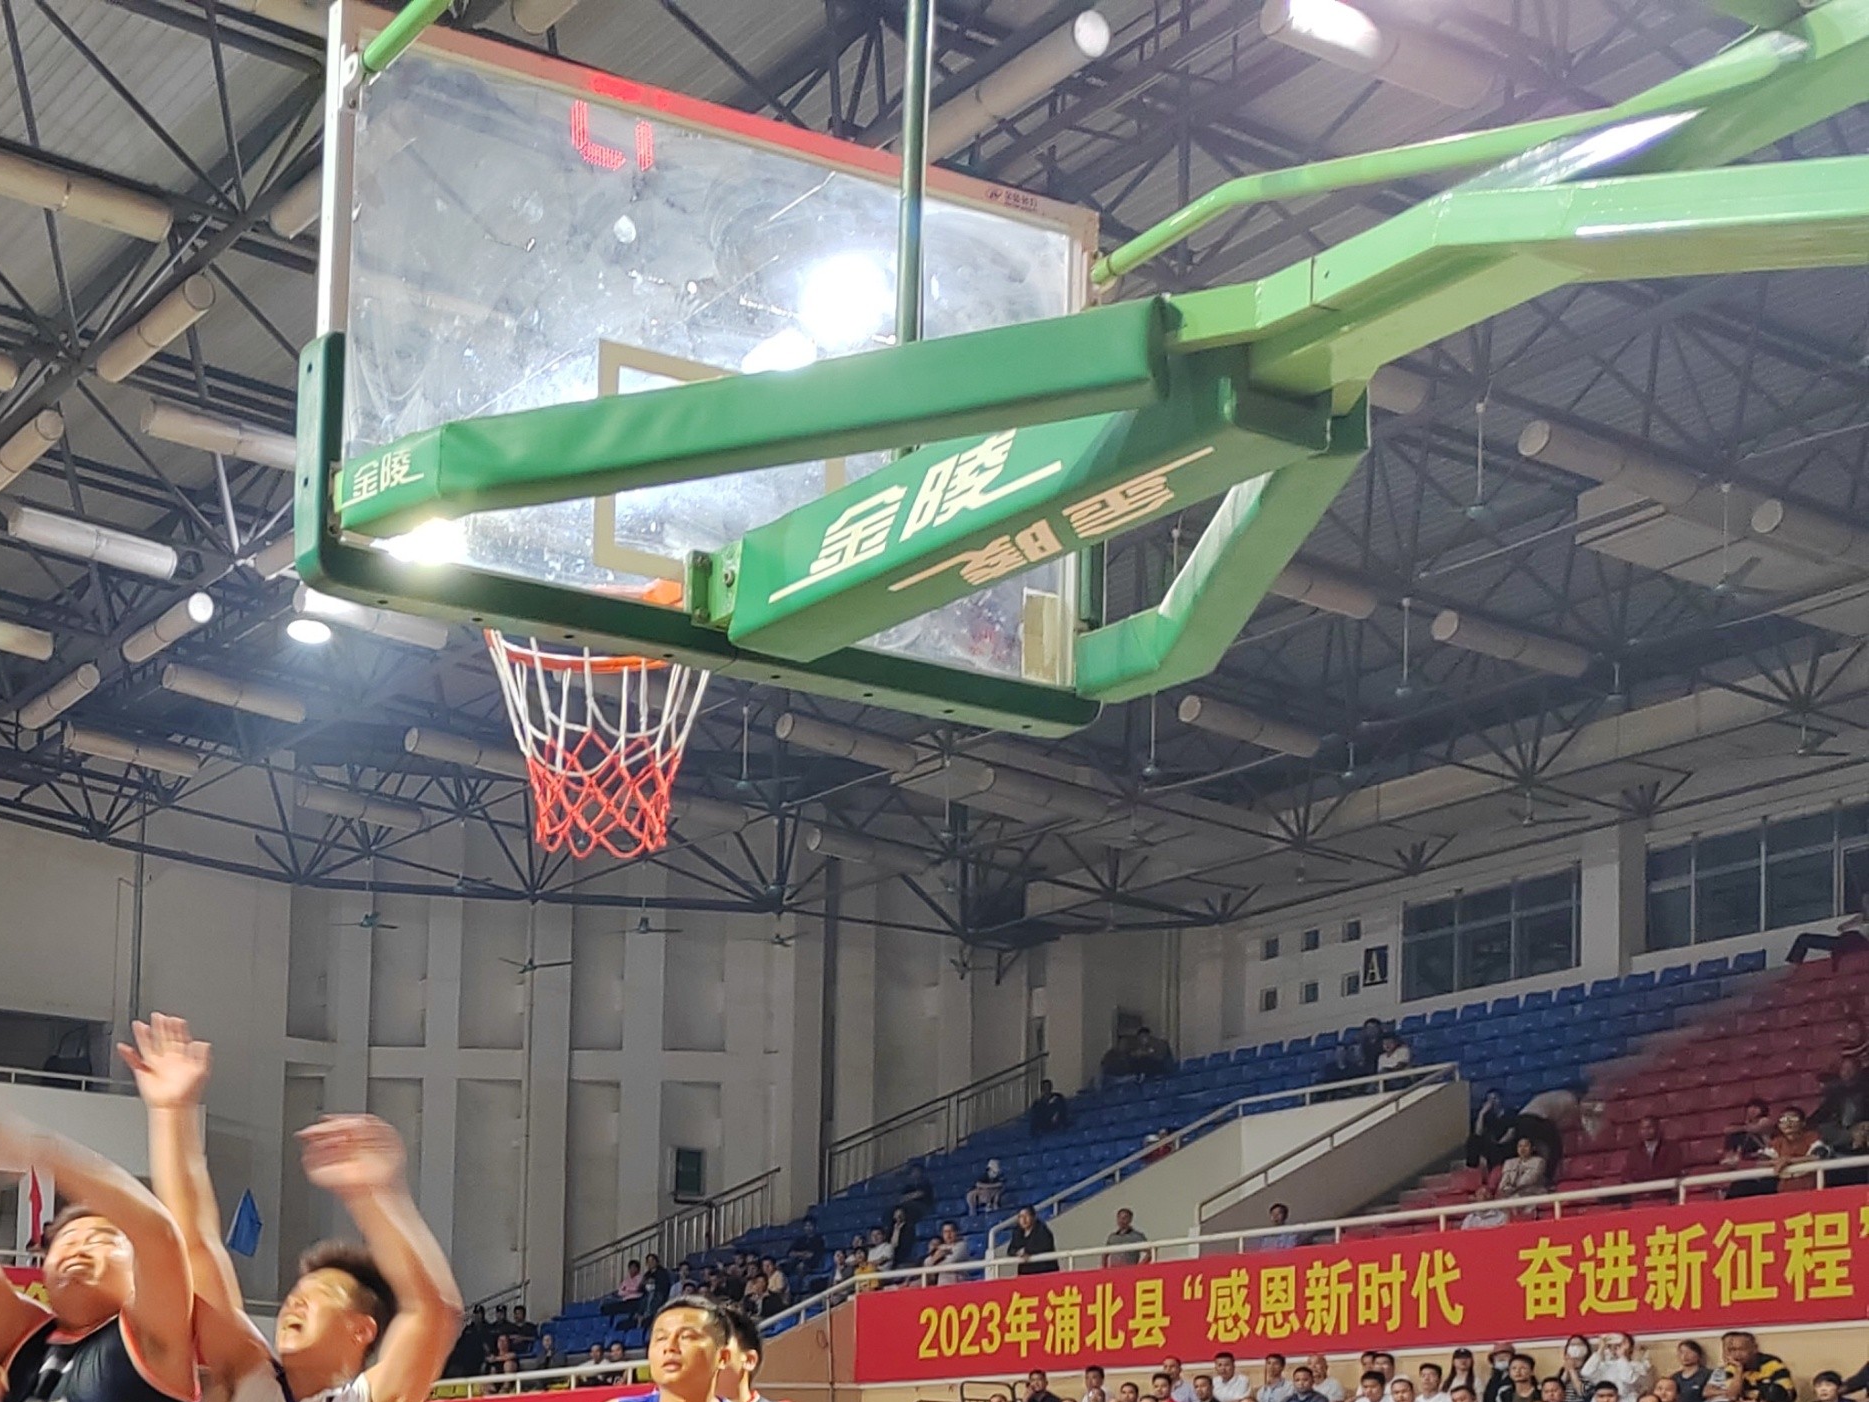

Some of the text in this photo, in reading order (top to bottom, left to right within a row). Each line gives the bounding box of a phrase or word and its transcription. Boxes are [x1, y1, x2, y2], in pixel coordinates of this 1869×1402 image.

[342, 450, 425, 509] 金陵
[768, 428, 1062, 603] 金陵
[1365, 951, 1382, 984] A
